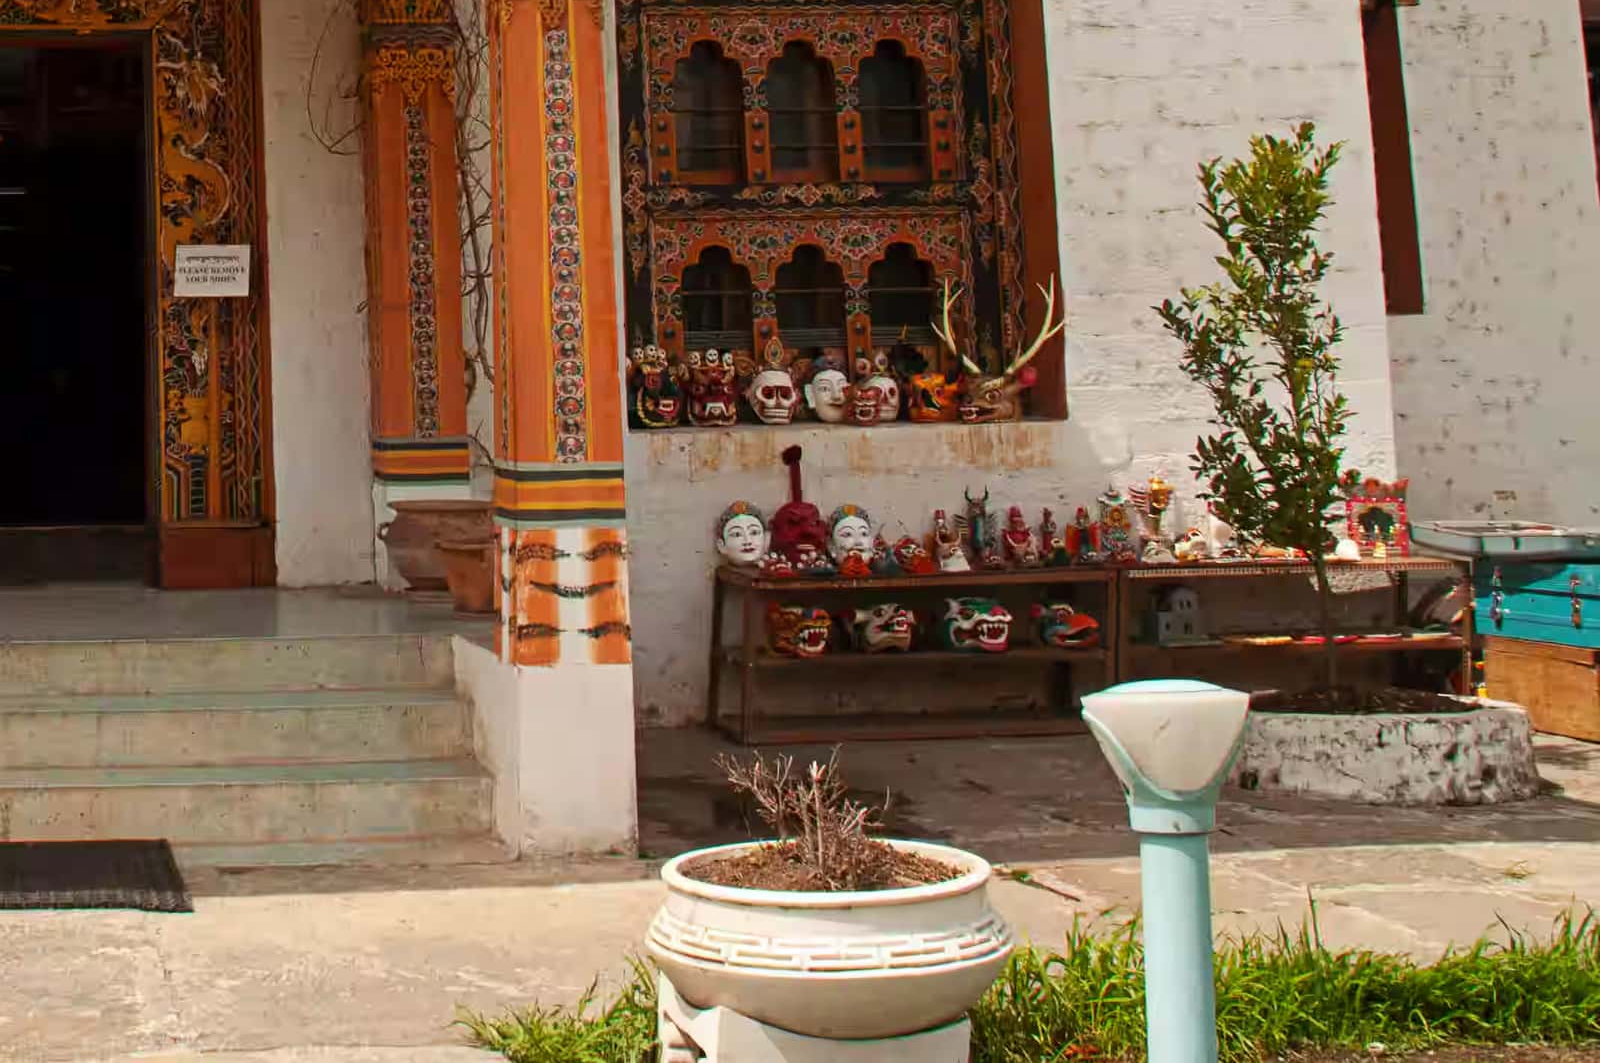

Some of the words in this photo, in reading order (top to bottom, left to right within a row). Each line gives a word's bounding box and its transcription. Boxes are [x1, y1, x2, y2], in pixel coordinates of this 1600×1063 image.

[179, 266, 207, 274] PLEASE
[210, 266, 244, 274] REMOVE
[185, 275, 208, 283] YOUR
[210, 275, 237, 283] SHOES
